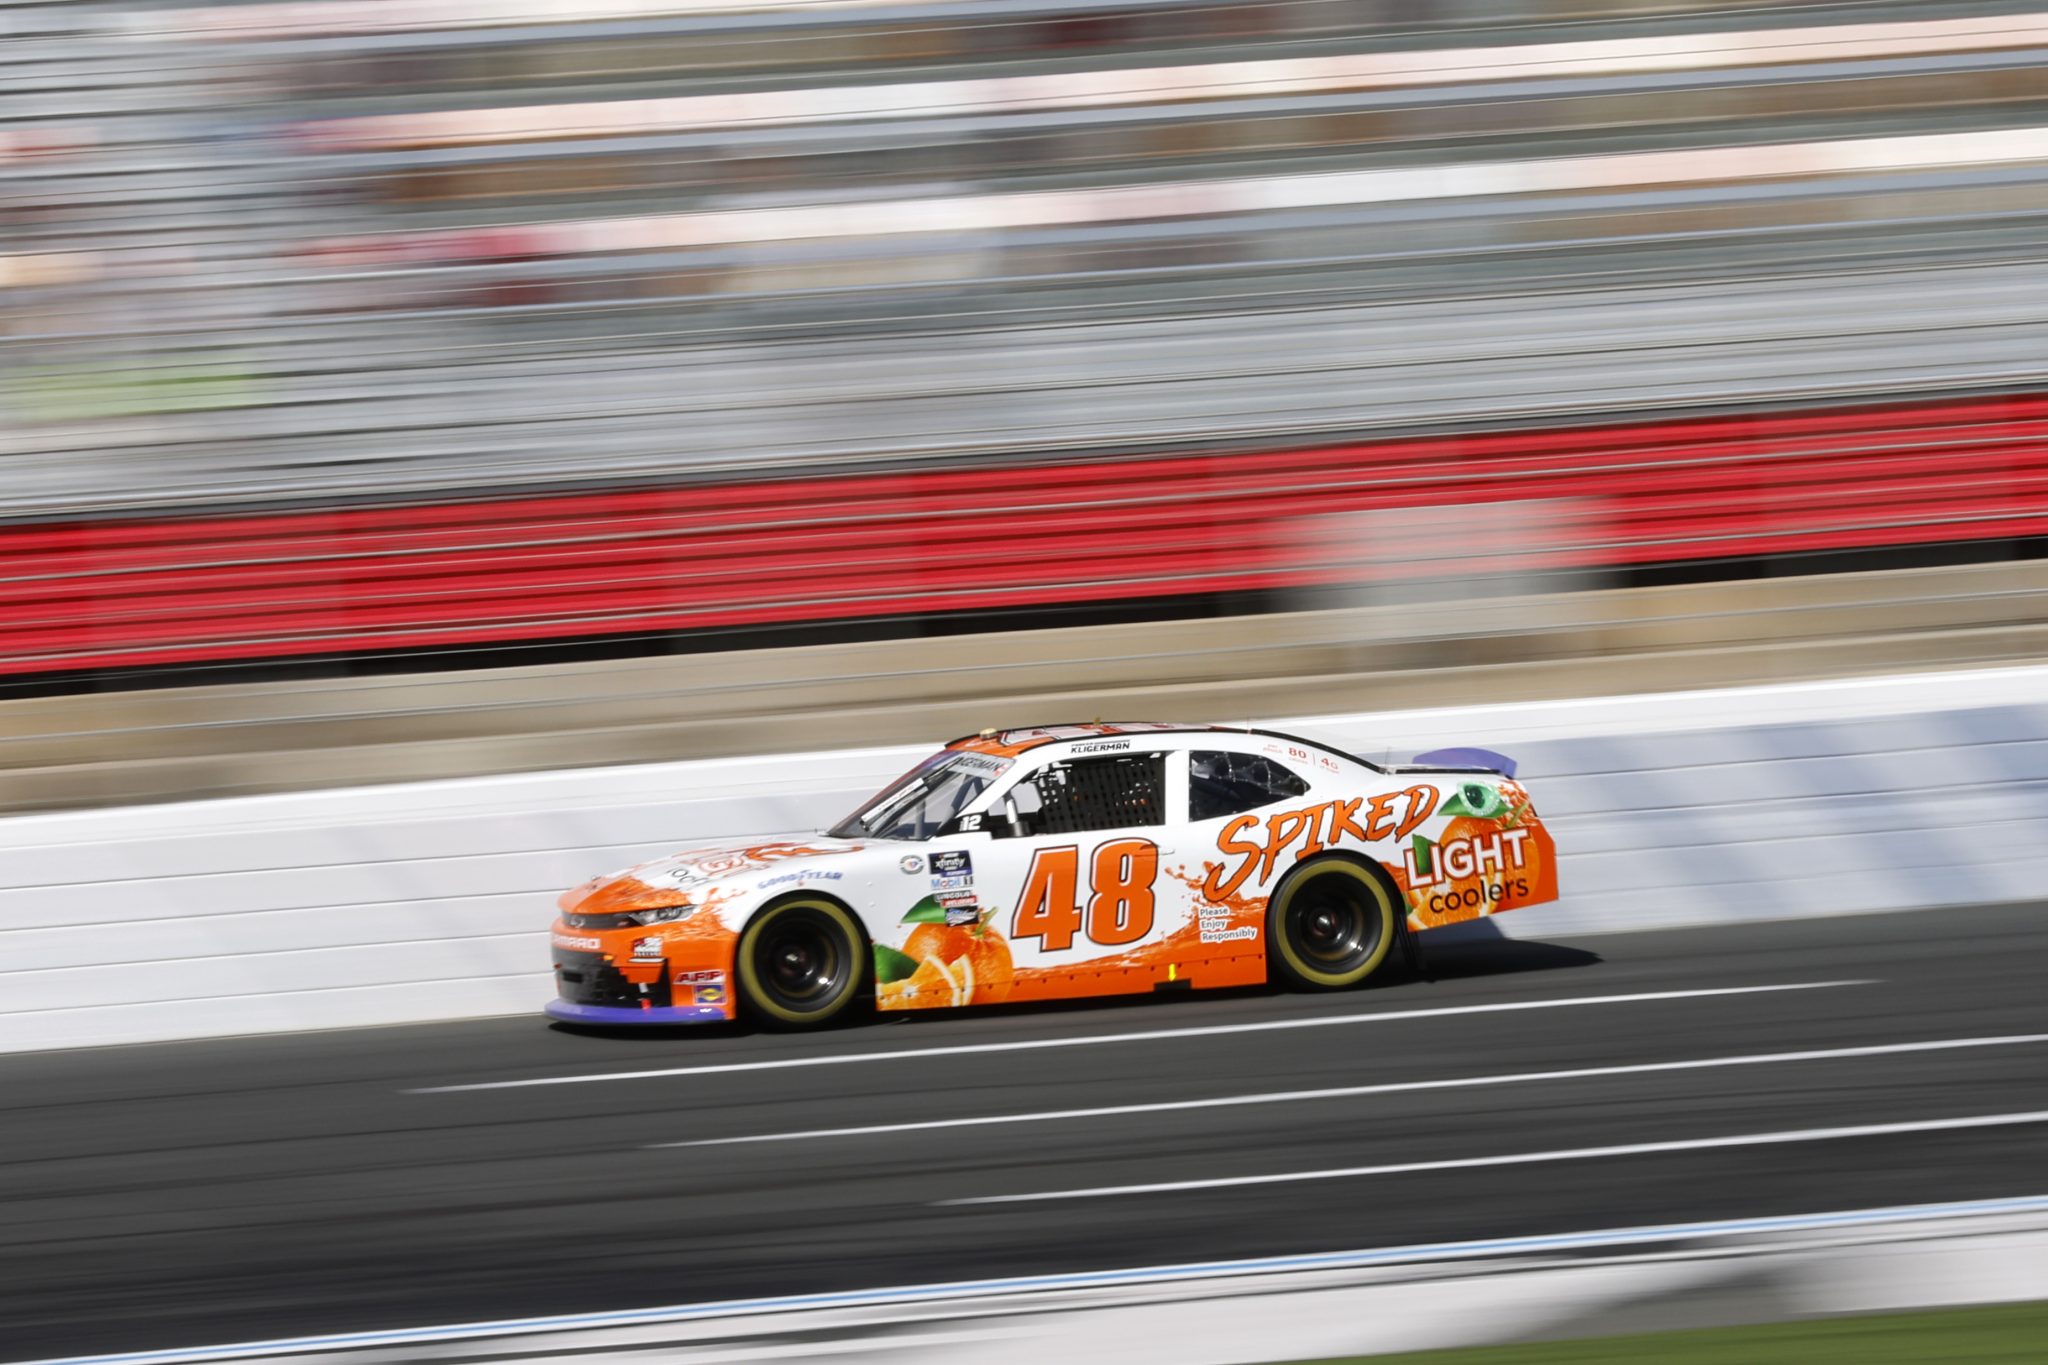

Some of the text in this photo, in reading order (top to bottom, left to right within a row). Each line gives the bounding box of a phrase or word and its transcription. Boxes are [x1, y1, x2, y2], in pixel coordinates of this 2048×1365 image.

[1071, 742, 1131, 754] KLIGERMAN
[1288, 747, 1307, 759] 80
[959, 814, 983, 832] 12
[1202, 784, 1440, 902] SPIKED
[1403, 827, 1530, 891] LIGHT
[1010, 837, 1159, 953] 48
[1429, 877, 1529, 914] coolers
[1200, 907, 1229, 917] Please
[1201, 920, 1226, 930] Enjoy
[1202, 928, 1257, 941] Responsibly
